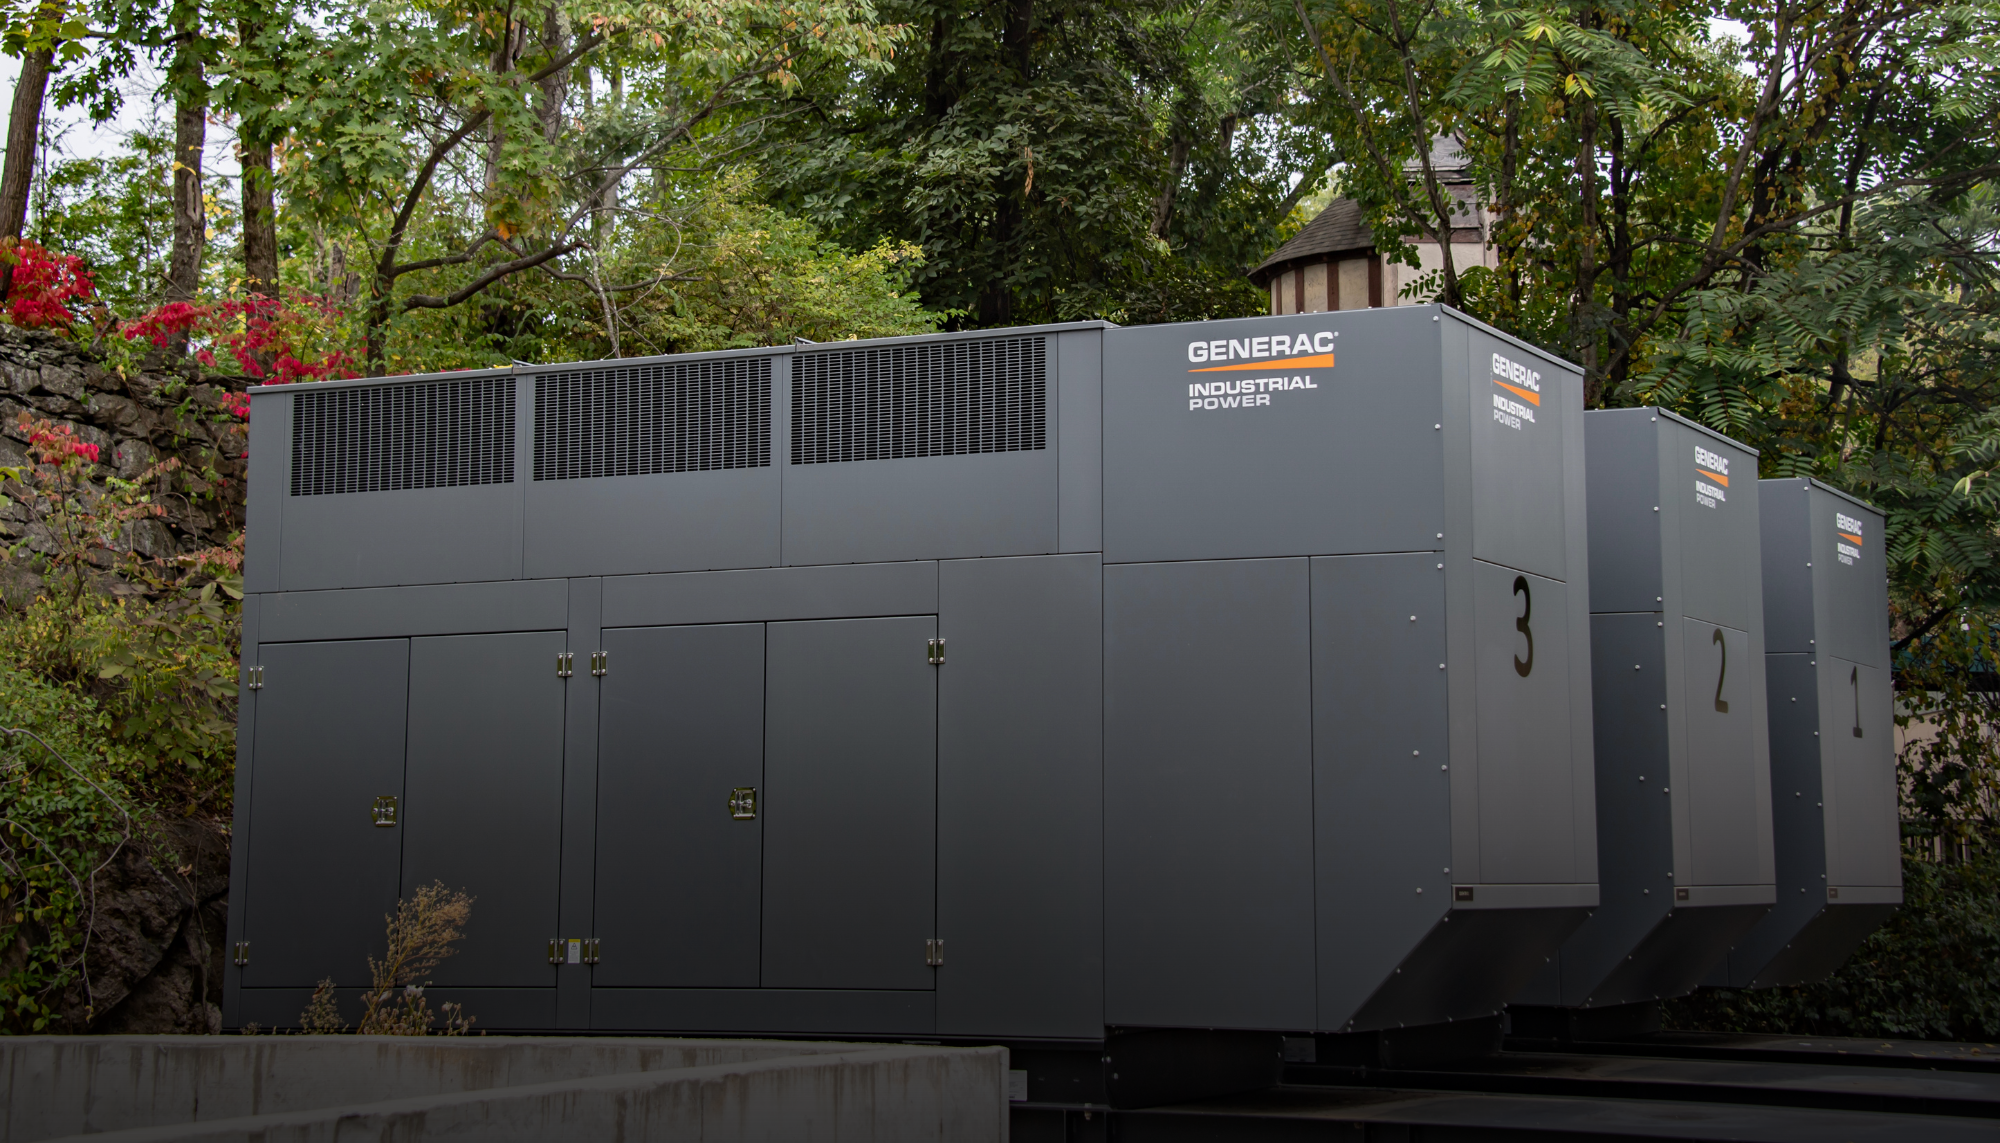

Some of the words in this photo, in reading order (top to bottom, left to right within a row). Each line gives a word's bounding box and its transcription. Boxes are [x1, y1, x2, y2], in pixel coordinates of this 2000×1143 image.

[1188, 331, 1335, 363] GENERAC
[1189, 375, 1318, 397] INDUSTRIAL
[1492, 352, 1540, 392] GENERAC
[1189, 394, 1271, 411] POWER
[1493, 393, 1536, 423] INDUSTRIAL
[1493, 408, 1521, 431] POWER
[1694, 445, 1729, 476] GENERAC
[1513, 575, 1533, 678] 3
[1712, 628, 1729, 714] 2
[1850, 665, 1863, 739] 1
